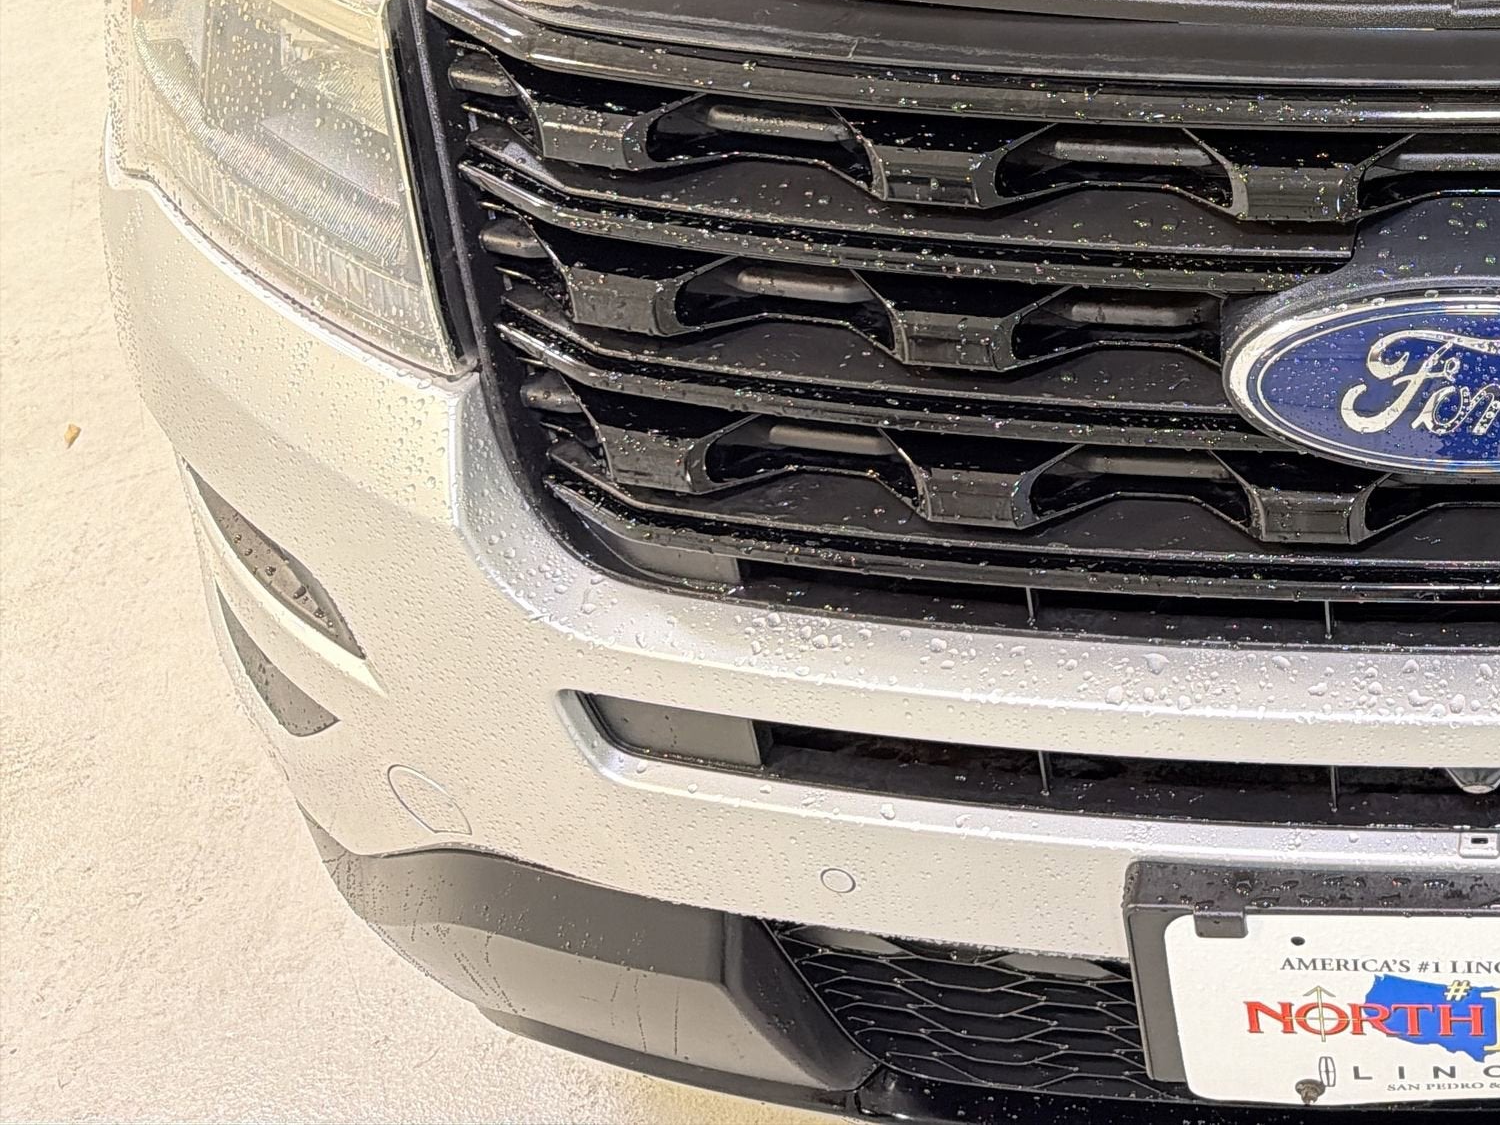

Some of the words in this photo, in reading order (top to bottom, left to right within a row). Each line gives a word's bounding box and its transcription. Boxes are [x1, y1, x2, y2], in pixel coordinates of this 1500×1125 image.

[1279, 957, 1411, 973] AMERICA'S
[1417, 961, 1441, 974] #1
[1243, 1001, 1486, 1038] NORTH
[1387, 1083, 1421, 1092] SAN
[1426, 1081, 1485, 1091] PEDRO
